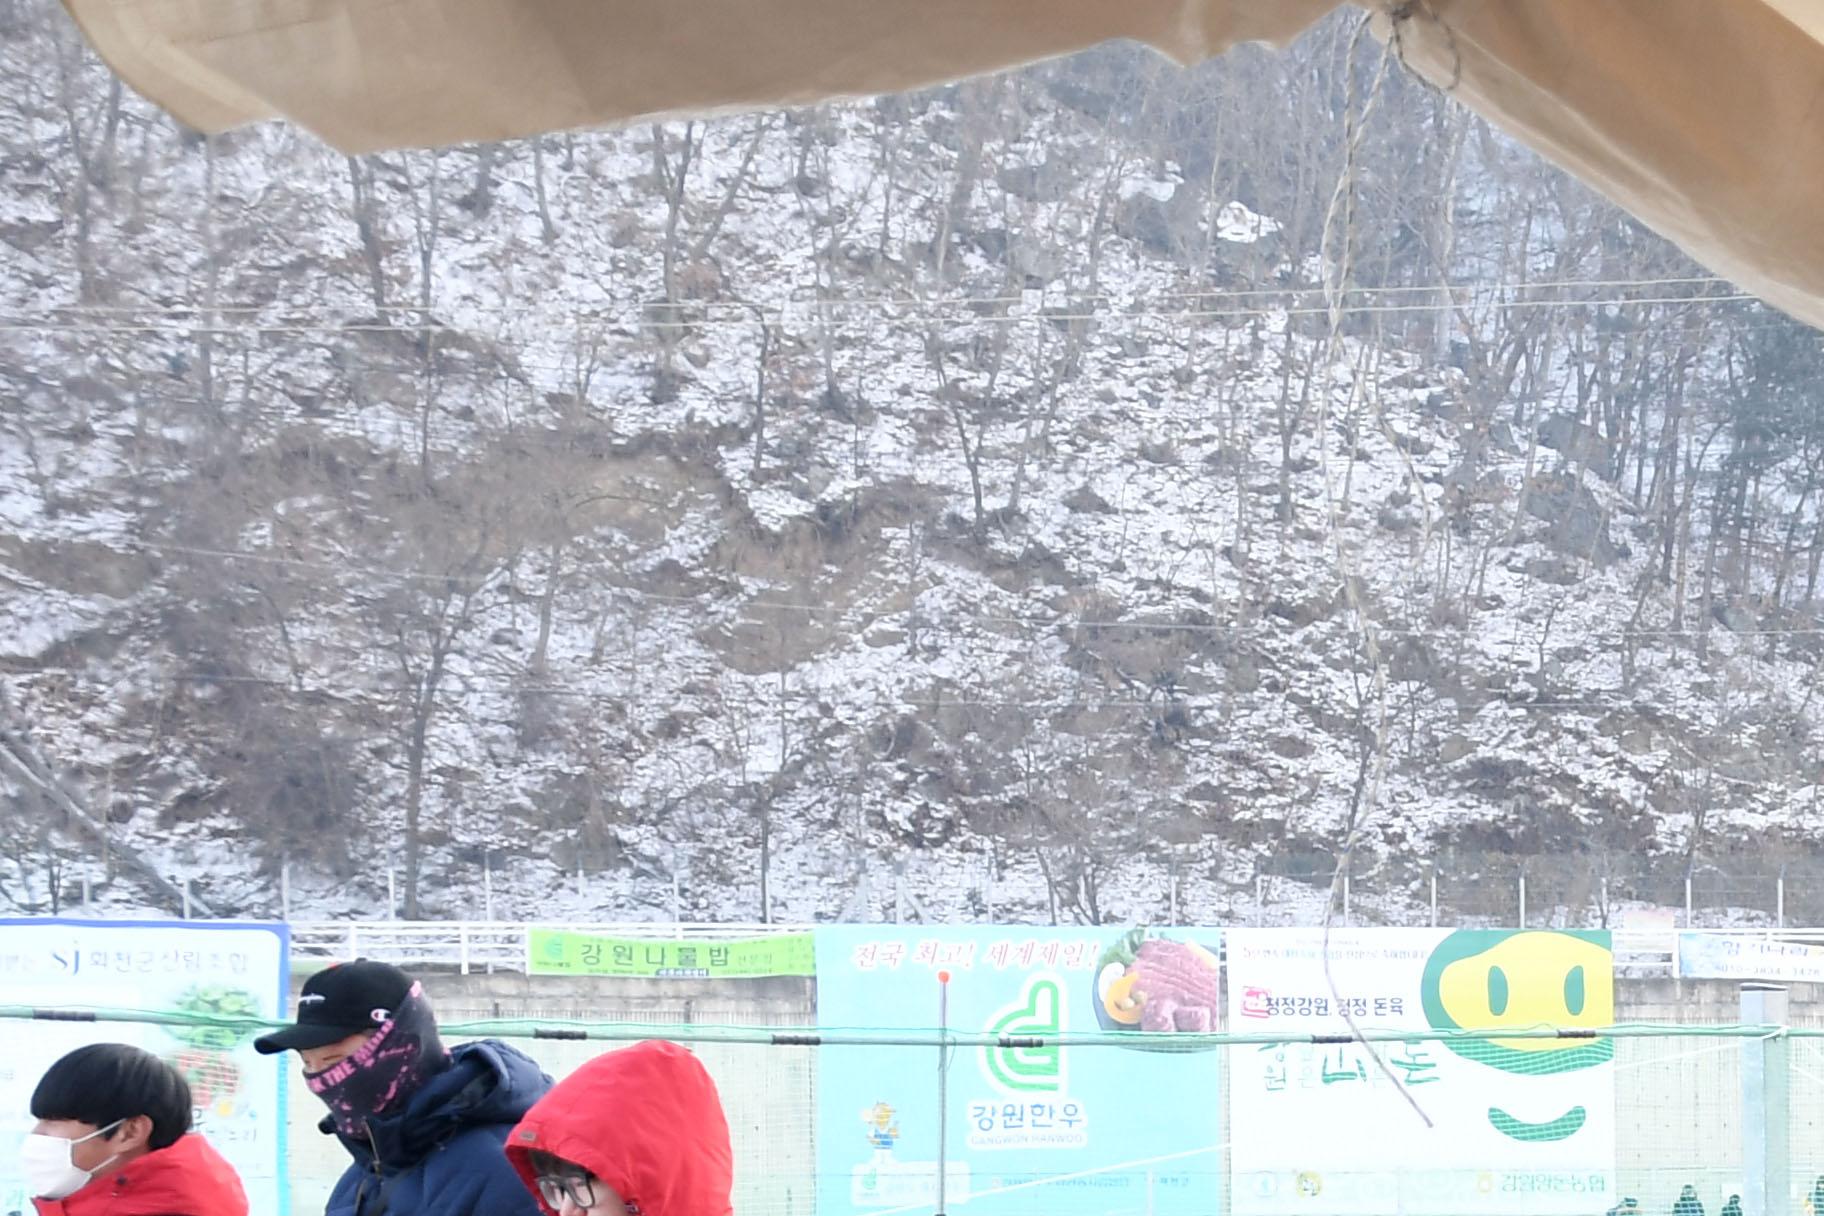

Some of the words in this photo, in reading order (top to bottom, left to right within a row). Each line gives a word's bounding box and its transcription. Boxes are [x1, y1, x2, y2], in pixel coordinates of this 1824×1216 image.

[857, 943, 905, 968] 전국
[914, 942, 976, 968] 최고!
[986, 941, 1099, 968] 세계제일!
[1373, 997, 1404, 1017] 돈육
[972, 1103, 1083, 1132] 강원한우
